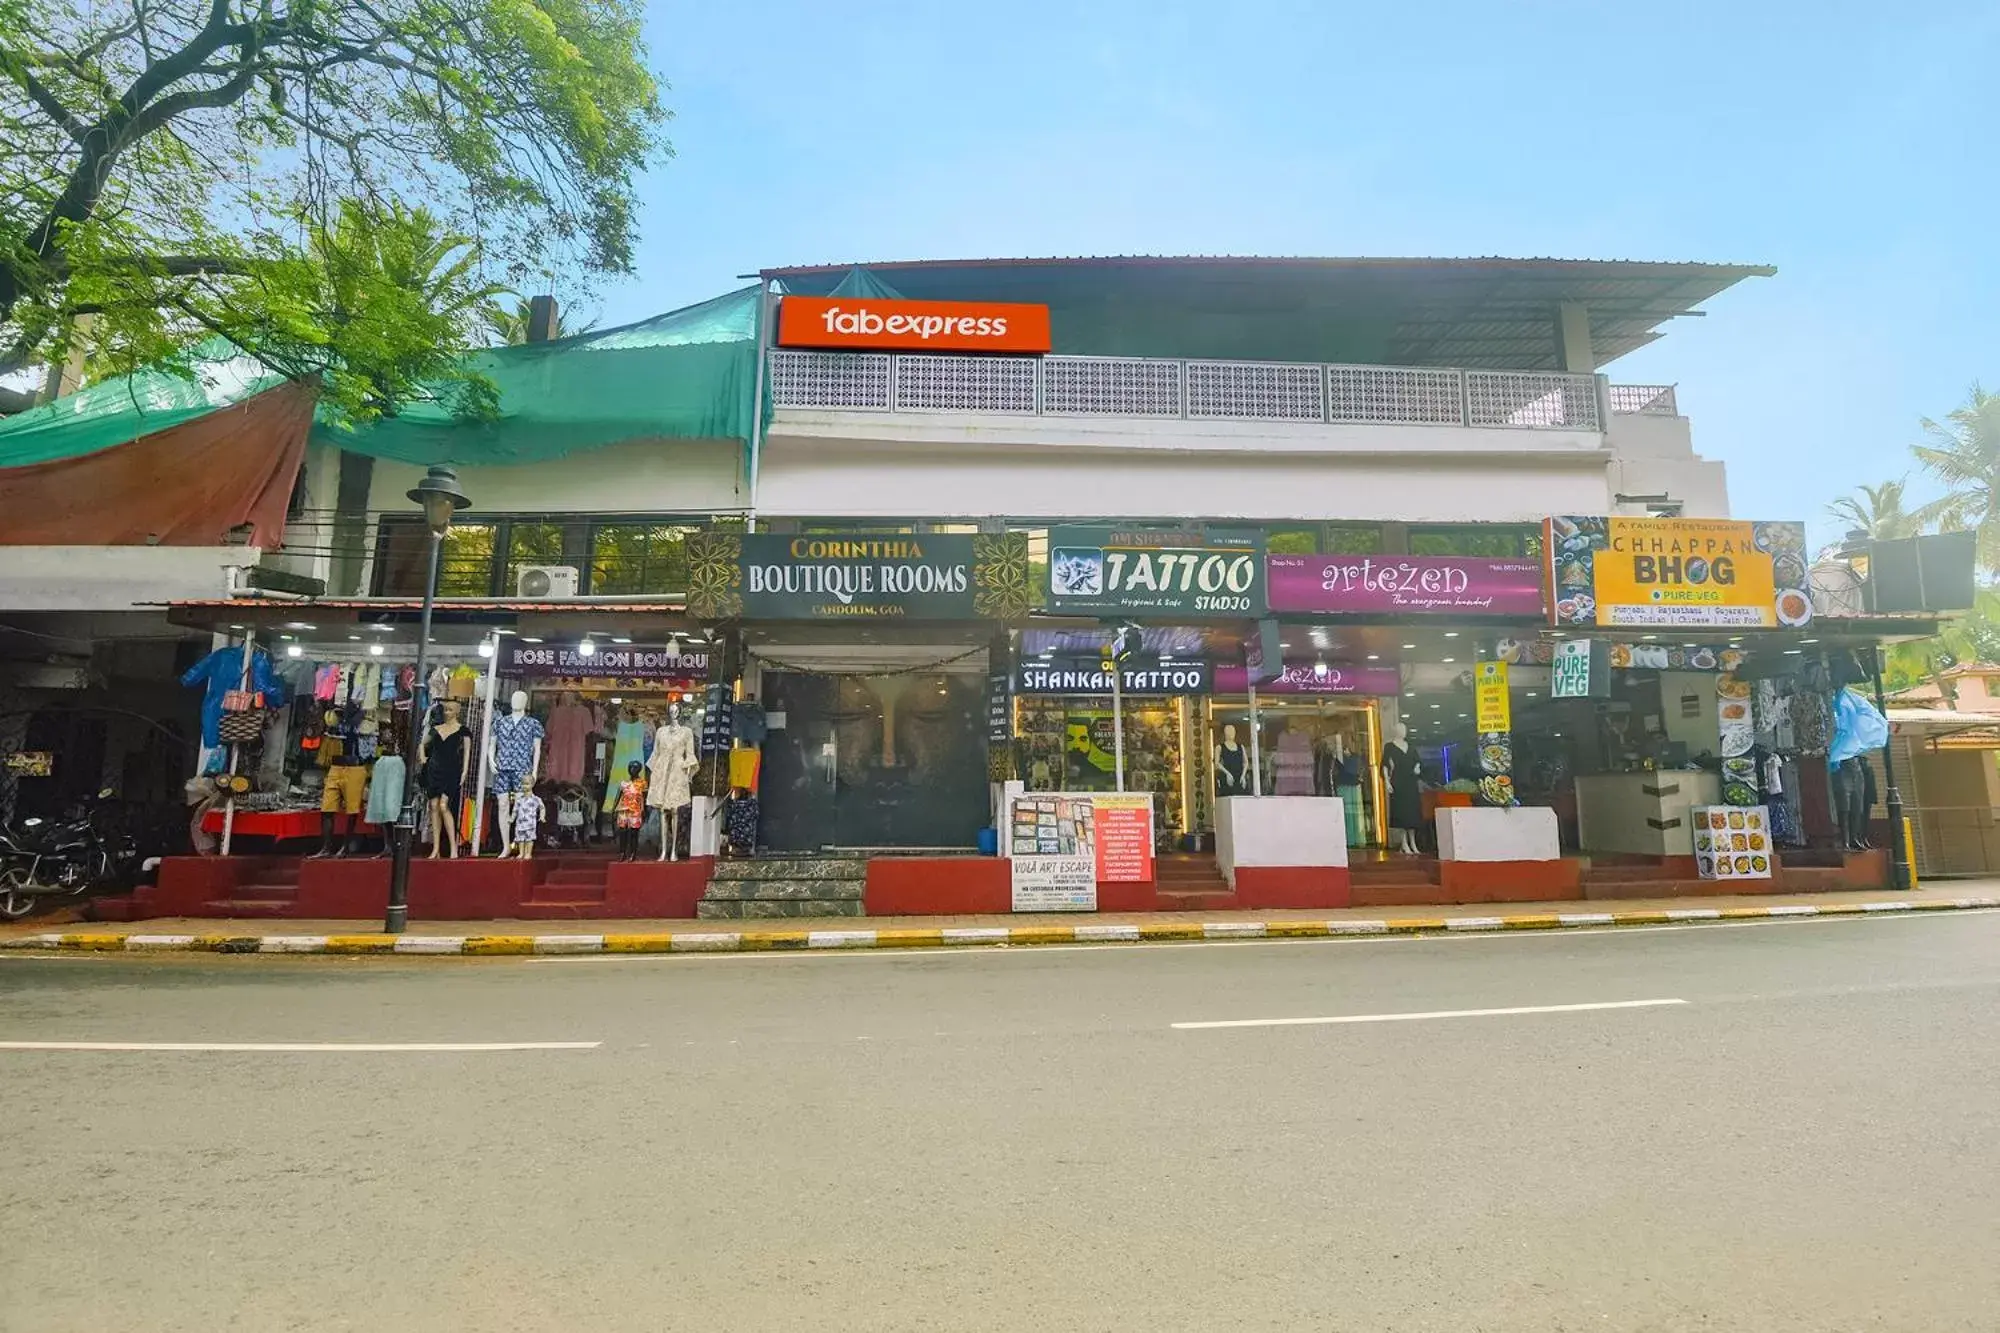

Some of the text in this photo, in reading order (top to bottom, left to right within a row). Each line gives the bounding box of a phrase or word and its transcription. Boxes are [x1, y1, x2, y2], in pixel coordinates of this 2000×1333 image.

[821, 307, 1008, 339] fabexpress
[1630, 522, 1667, 531] FAMILY
[790, 538, 923, 559] CORINTHIA
[1613, 537, 1752, 554] CHHAPPAN
[1107, 553, 1254, 593] TATTOO
[1322, 559, 1468, 594] artezen
[1634, 555, 1736, 585] BHOG
[749, 564, 967, 604] BOUTIQUE ROOMS
[1195, 595, 1251, 610] STUDIO
[1663, 591, 1720, 601] PURE VEG
[880, 605, 905, 616] GOA
[1678, 617, 1710, 625] Chinese
[1743, 617, 1762, 625] Food
[514, 649, 709, 669] ROSE FASHION BOUTIQU
[1554, 655, 1589, 677] PURE
[1124, 671, 1201, 689] TATTOO
[1554, 674, 1587, 696] VEG
